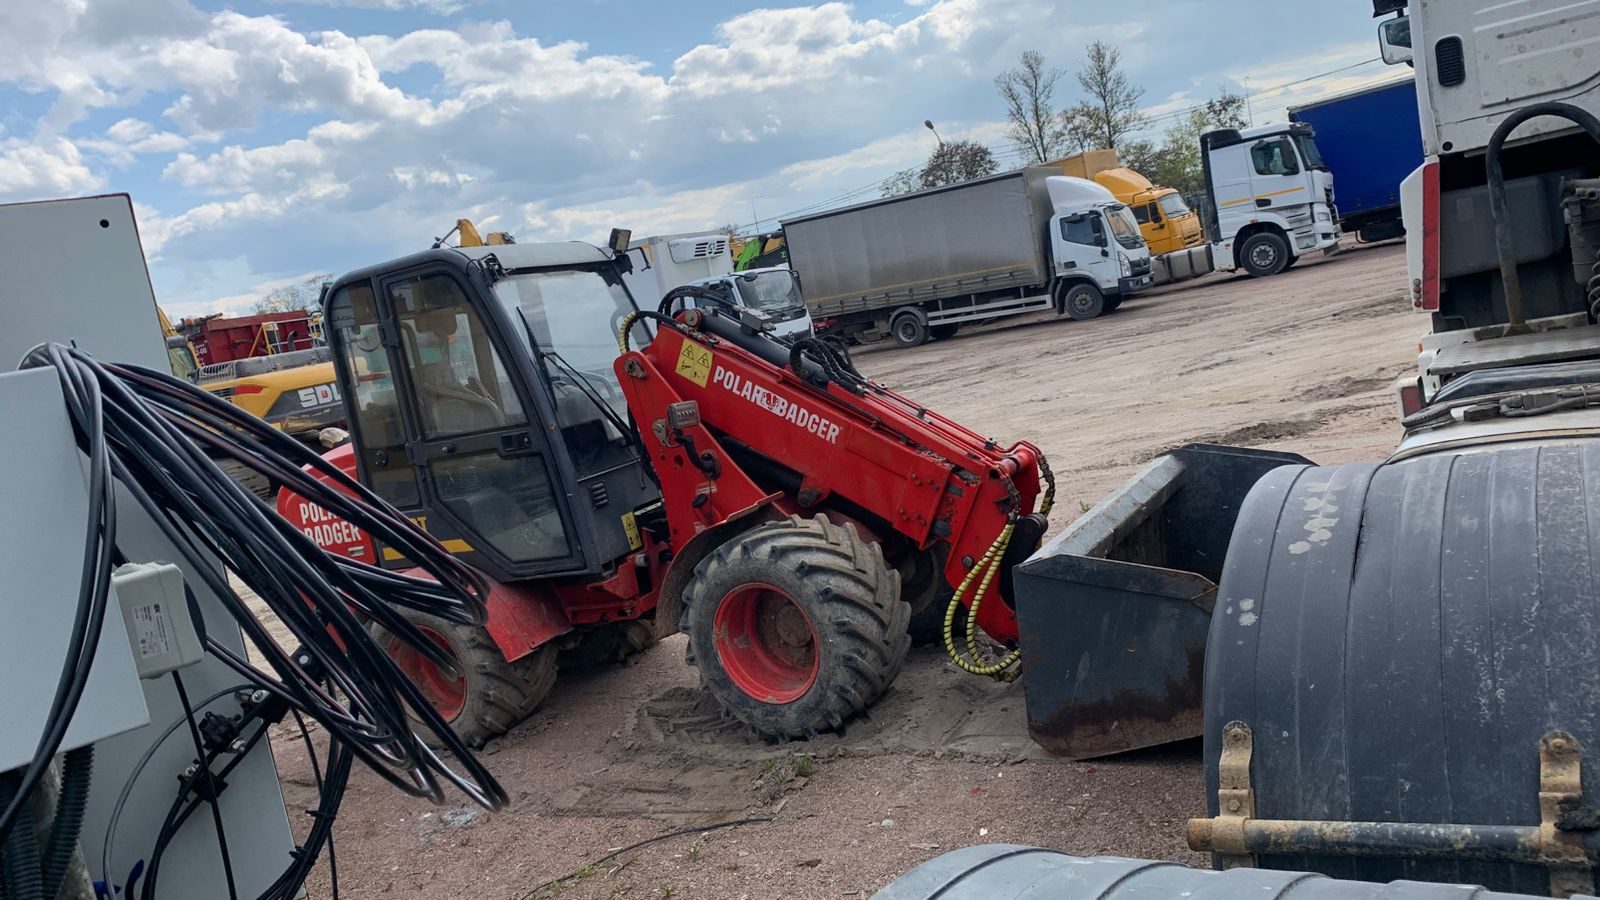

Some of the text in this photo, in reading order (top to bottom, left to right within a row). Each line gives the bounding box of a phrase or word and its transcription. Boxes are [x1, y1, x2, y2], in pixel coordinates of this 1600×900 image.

[298, 383, 342, 408] SDL
[713, 366, 840, 444] POLAR BADGER
[299, 502, 341, 524] POL
